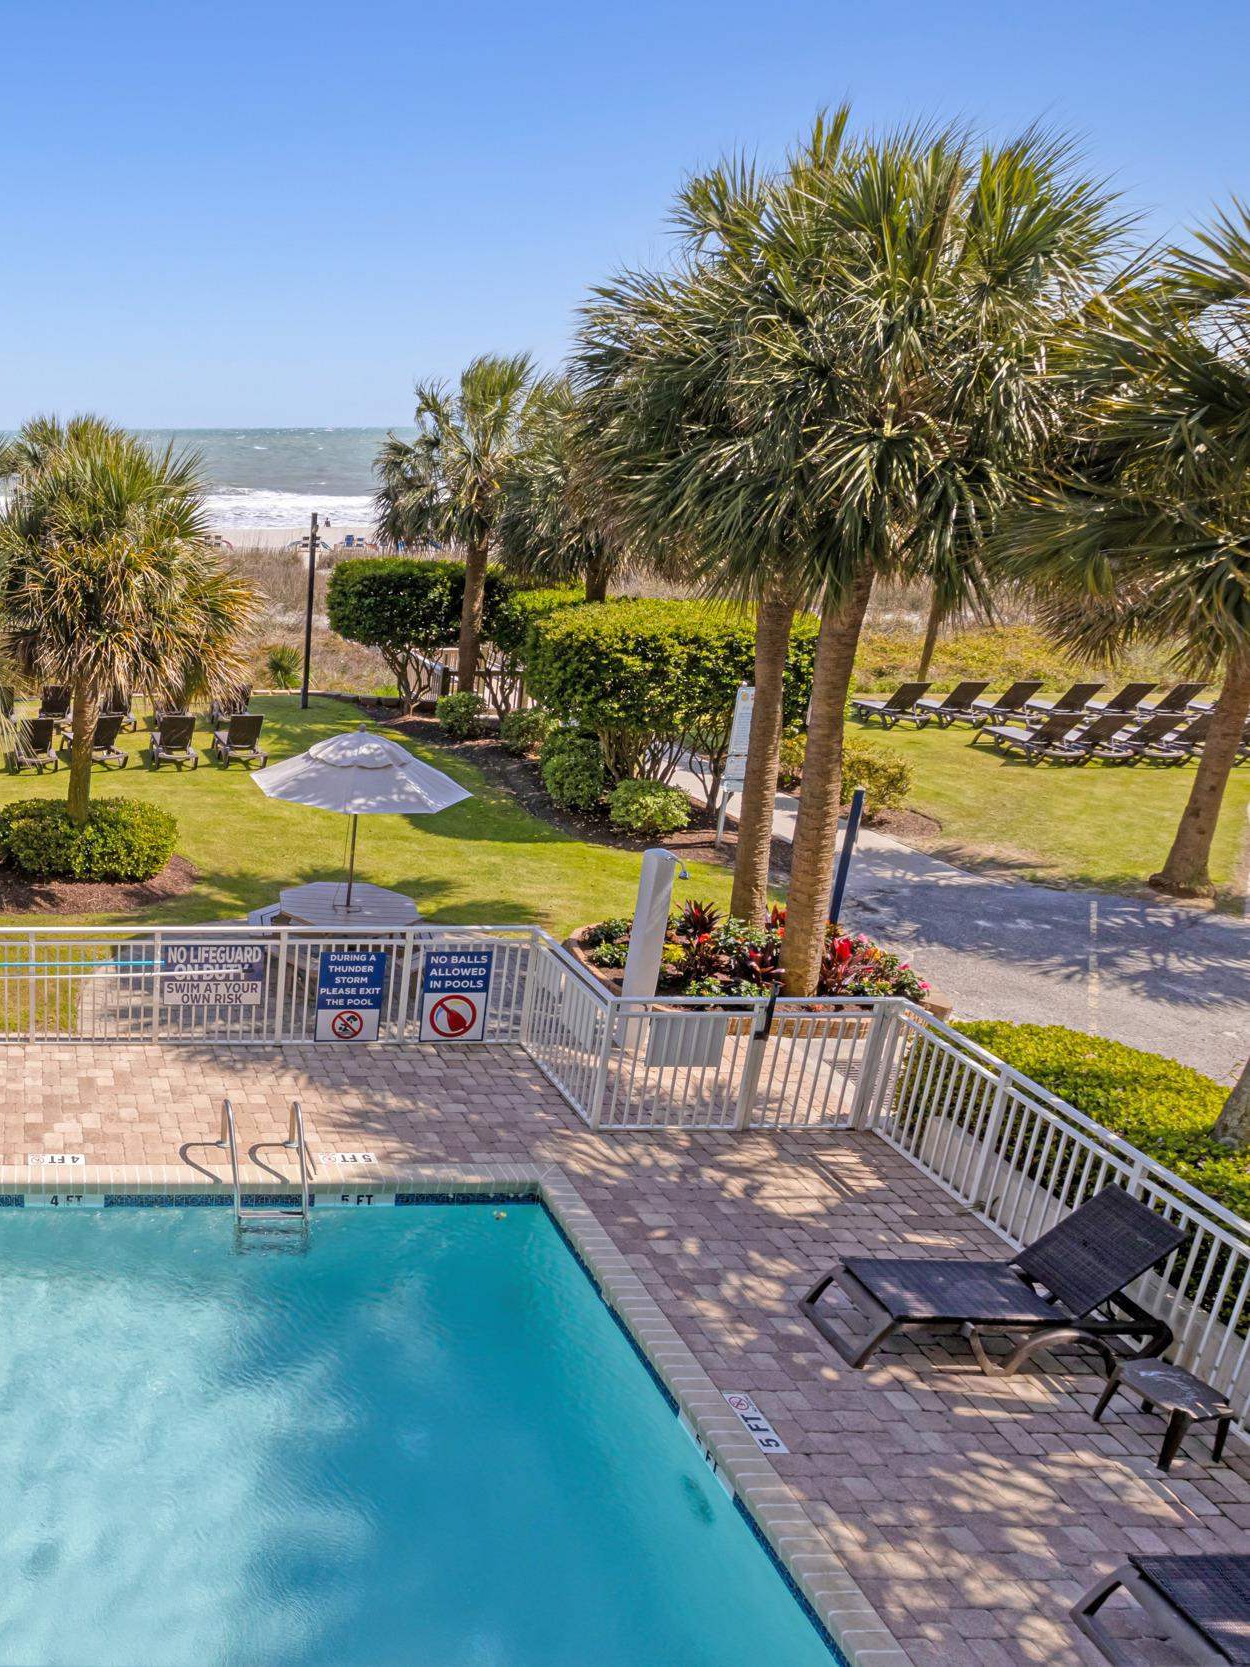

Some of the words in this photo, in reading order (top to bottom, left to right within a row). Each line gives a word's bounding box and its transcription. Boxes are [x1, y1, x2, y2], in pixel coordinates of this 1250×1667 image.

[167, 946, 187, 964] NO
[190, 946, 262, 964] LIFEGUARD
[330, 954, 367, 962] DURING
[369, 954, 377, 962] A
[430, 955, 448, 964] NO
[451, 955, 488, 964] BALLS
[174, 963, 199, 981] ON
[203, 963, 250, 981] DUTY
[328, 965, 375, 973] THUNDER
[430, 967, 487, 976] ALLOWED
[335, 976, 368, 984] STORM
[430, 980, 442, 989] IN
[445, 980, 484, 988] POOLS
[166, 983, 200, 993] SWIM
[204, 983, 221, 993] AT
[225, 983, 259, 993] YOUR
[320, 987, 357, 995] PLEASE
[359, 987, 382, 995] EXIT
[181, 994, 211, 1004] OWN
[214, 994, 243, 1004] RISK
[325, 998, 345, 1006] THE
[346, 998, 373, 1006] POOL
[48, 1155, 66, 1163] FT
[71, 1155, 80, 1163] 4
[341, 1154, 358, 1163] FT
[362, 1154, 373, 1163] 5
[50, 1195, 59, 1206] 4
[66, 1195, 83, 1206] FT
[341, 1194, 350, 1206] 5
[357, 1194, 374, 1206] FT
[740, 1414, 770, 1432] FT
[757, 1438, 781, 1449] 5
